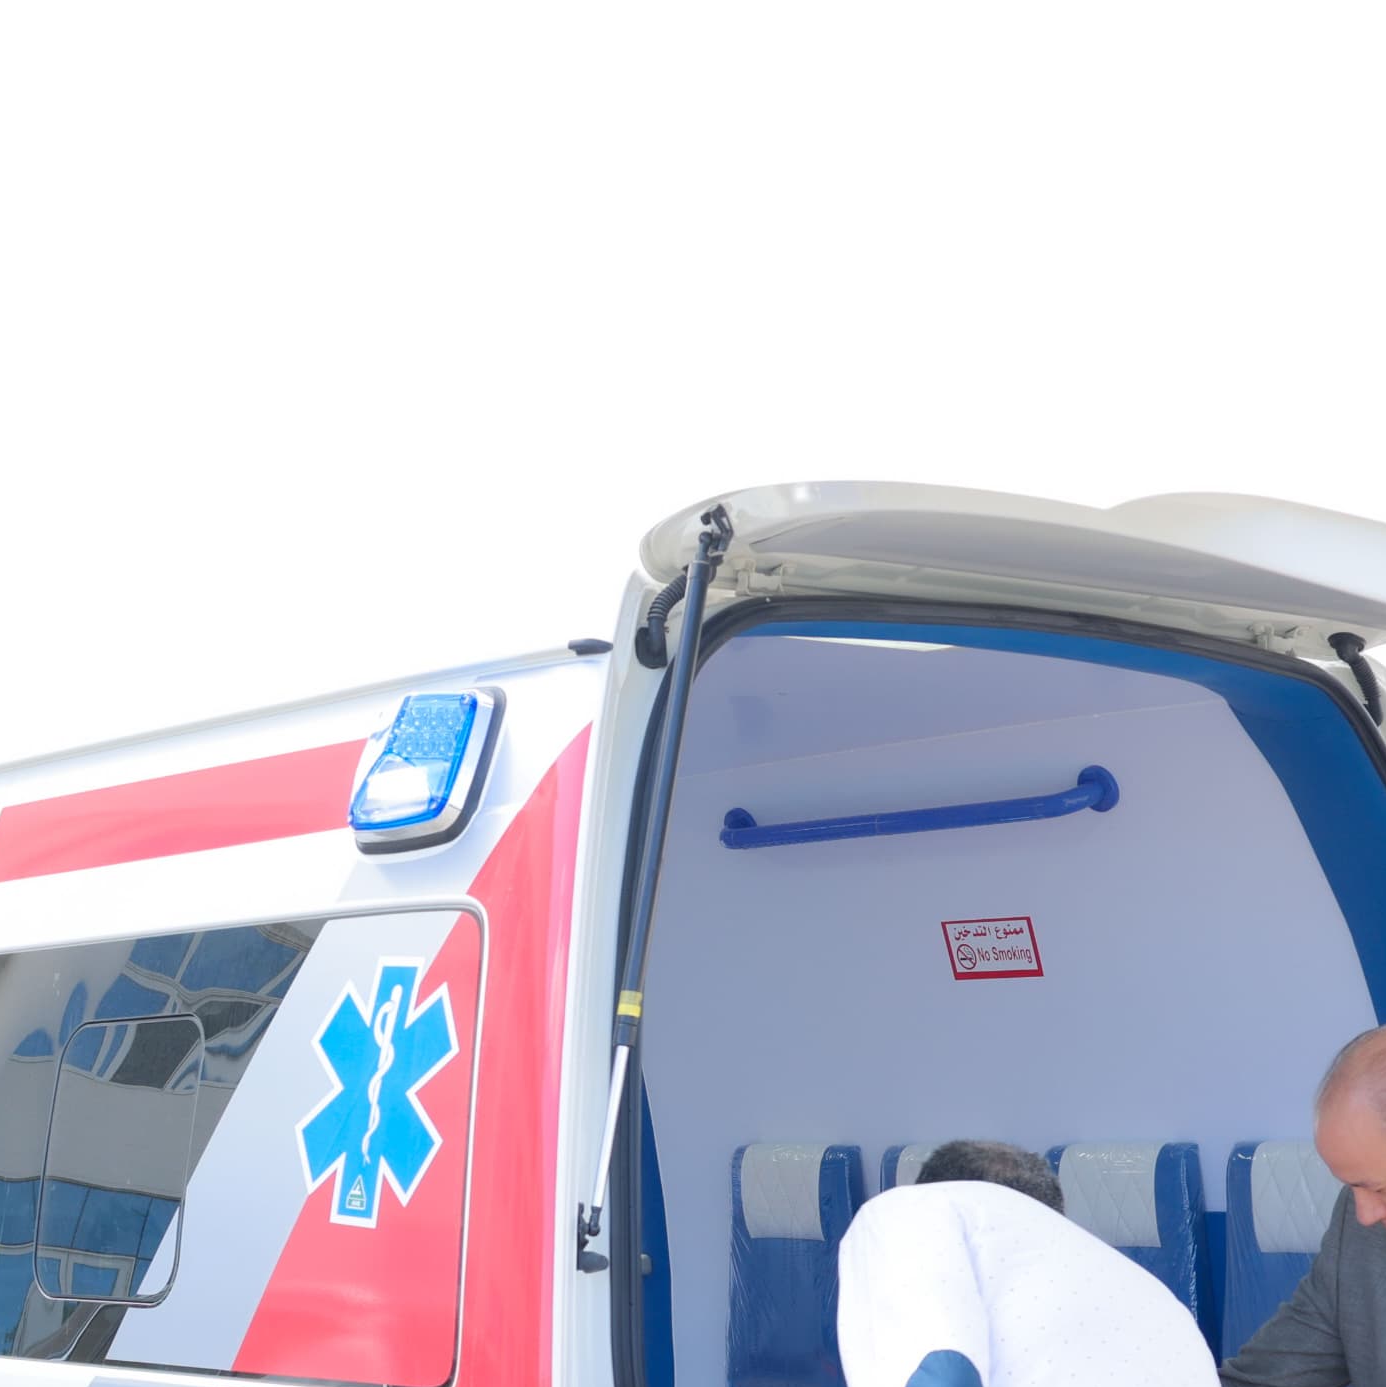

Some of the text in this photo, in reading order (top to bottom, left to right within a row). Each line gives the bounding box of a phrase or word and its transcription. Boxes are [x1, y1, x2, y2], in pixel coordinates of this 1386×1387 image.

[954, 923, 1025, 941] ممنوع التدخين
[977, 945, 1033, 964] No Smoking
